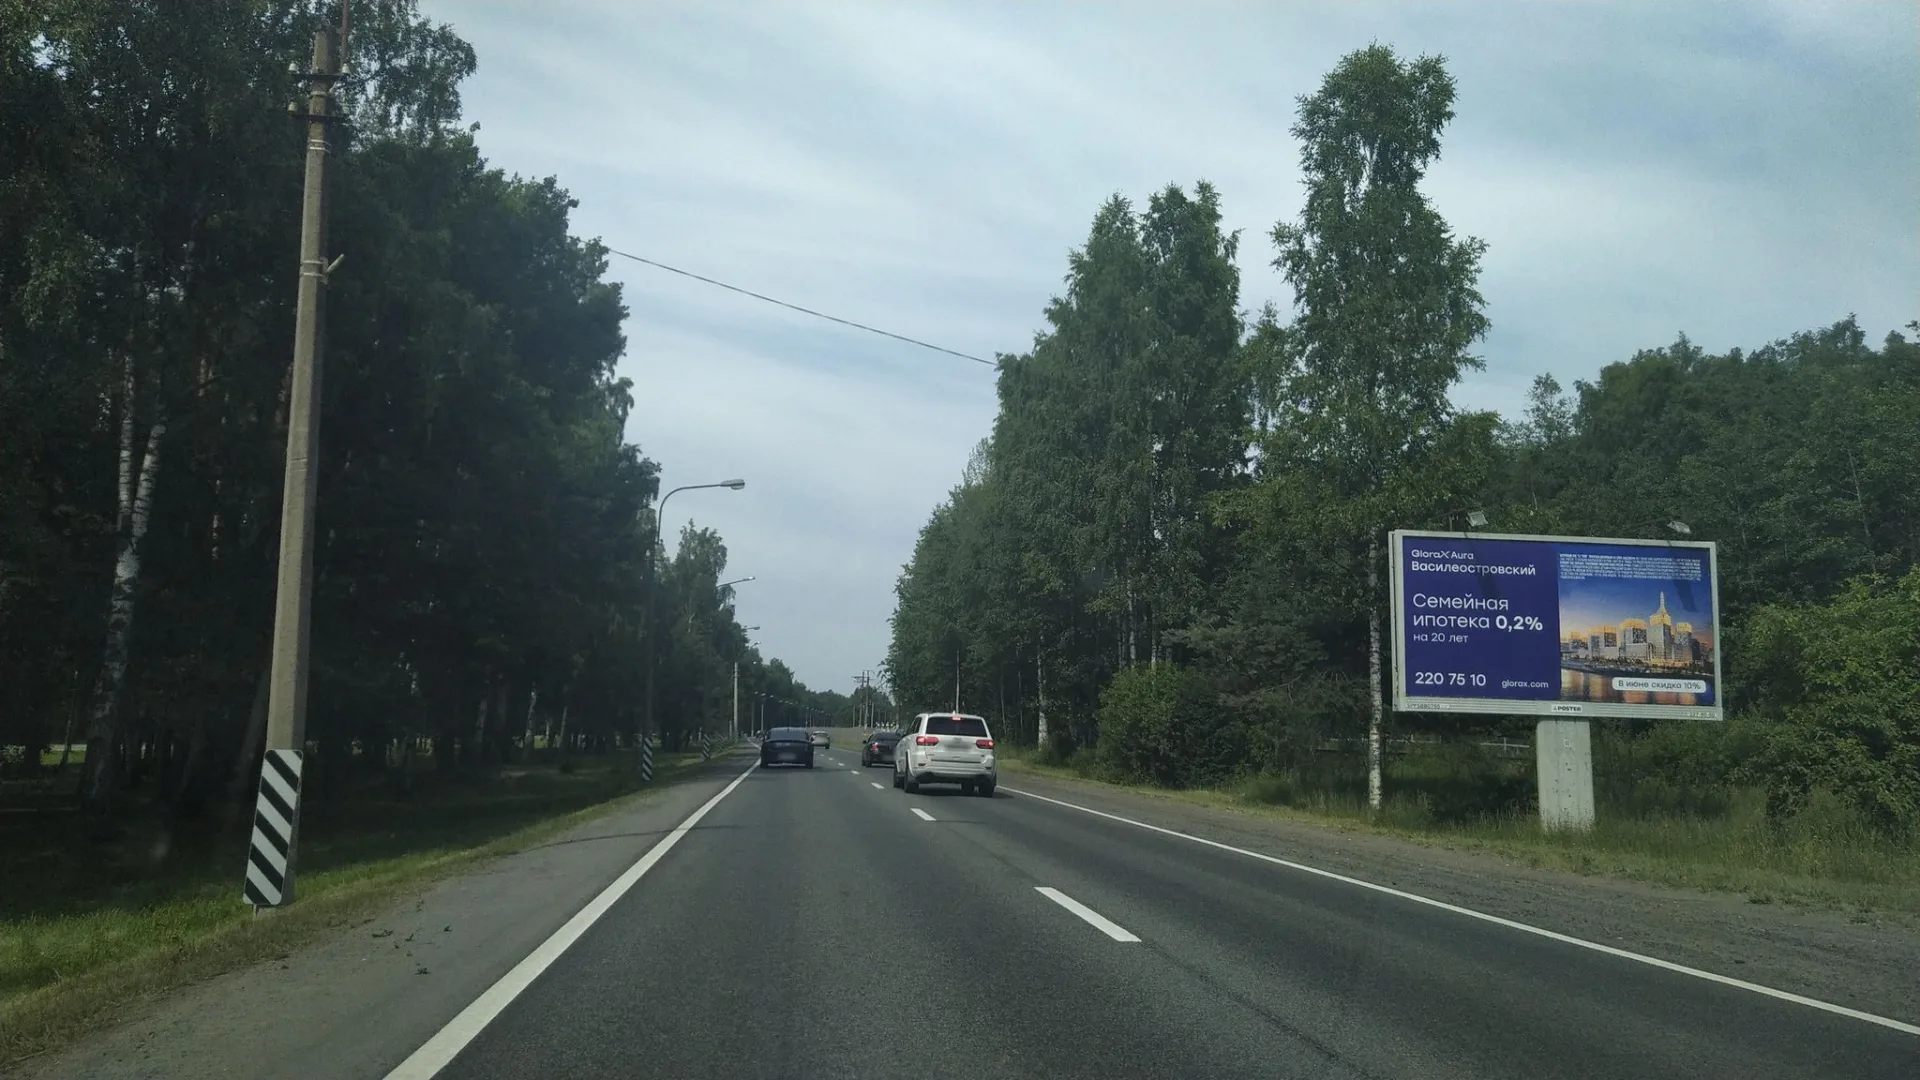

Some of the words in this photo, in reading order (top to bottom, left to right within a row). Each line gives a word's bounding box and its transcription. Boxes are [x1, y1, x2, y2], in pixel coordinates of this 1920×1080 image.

[1411, 549, 1450, 559] GloraX
[1451, 551, 1474, 560] Aura
[1411, 561, 1536, 576] Василеостровский
[1412, 593, 1509, 610] Семейная
[1413, 615, 1490, 628] ипотека
[1496, 615, 1543, 632] 0,2%
[1413, 634, 1428, 642] на
[1431, 633, 1446, 642] 20
[1448, 634, 1469, 643] лет
[1415, 672, 1444, 685] 220
[1448, 673, 1466, 686] 75
[1470, 673, 1486, 686] 10
[1501, 679, 1549, 689] glorax.com
[1626, 681, 1649, 689] июне
[1651, 682, 1682, 690] скидка
[1684, 682, 1702, 690] 10%
